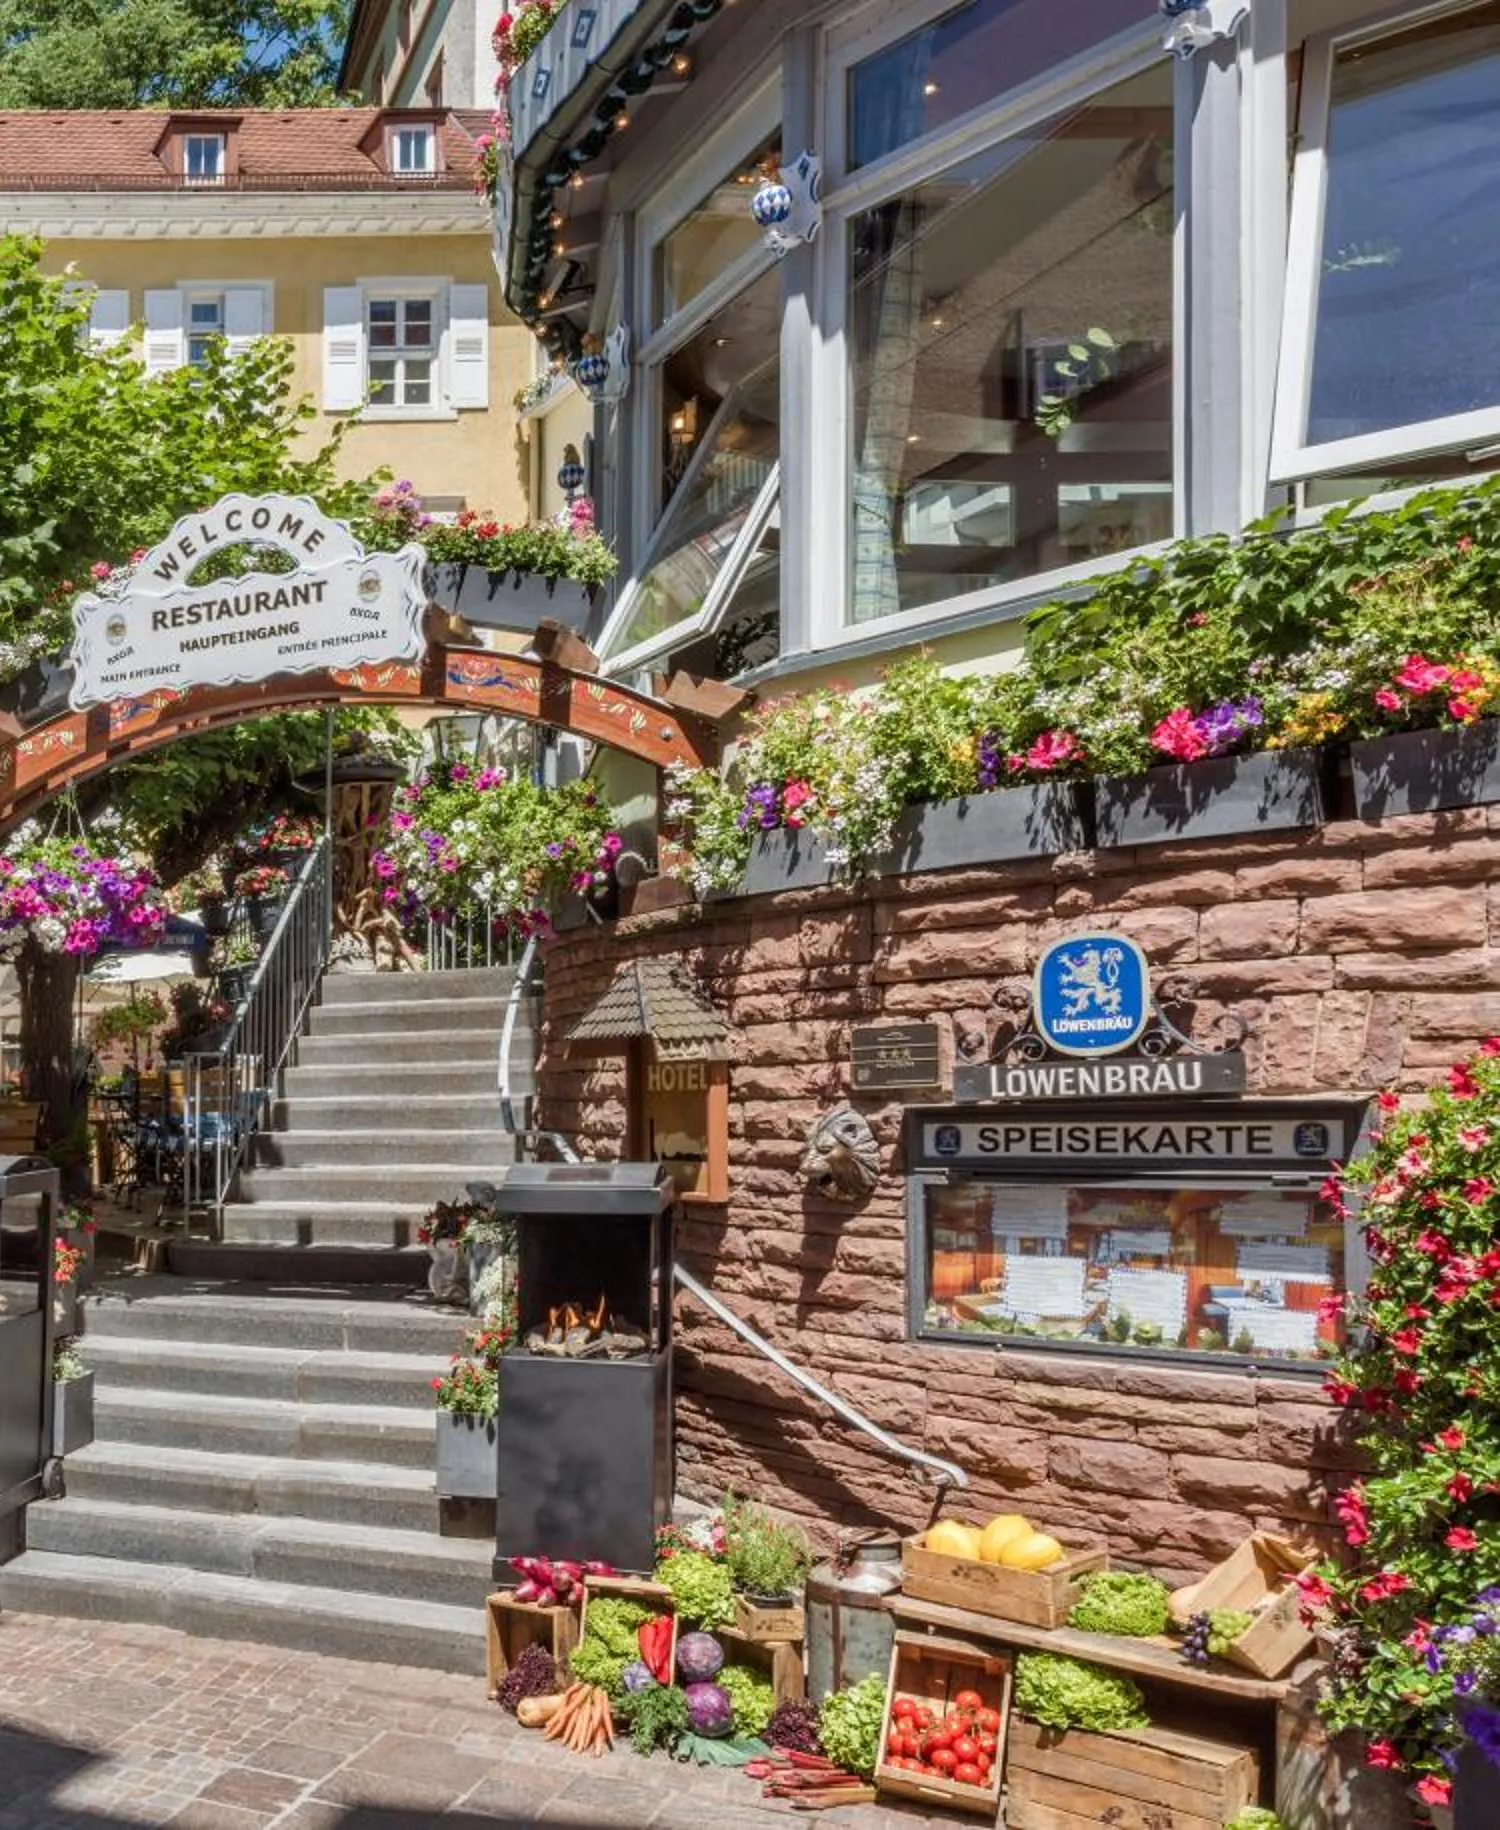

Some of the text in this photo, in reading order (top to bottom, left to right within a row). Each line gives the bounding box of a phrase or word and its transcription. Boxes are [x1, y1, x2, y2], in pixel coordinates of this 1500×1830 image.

[153, 507, 325, 582] WELCOME
[152, 580, 328, 632] RESTAURANT
[179, 621, 300, 653] HAUPTEINGANG
[321, 629, 388, 650] PRINCIPALE
[129, 663, 181, 681] ENTRANCE
[1053, 1016, 1133, 1033] LÖWENBRÄU
[647, 1063, 709, 1092] HOTEL
[990, 1056, 1202, 1098] LÖWENBRÄU
[977, 1126, 1273, 1154] SPEISEKARTE
